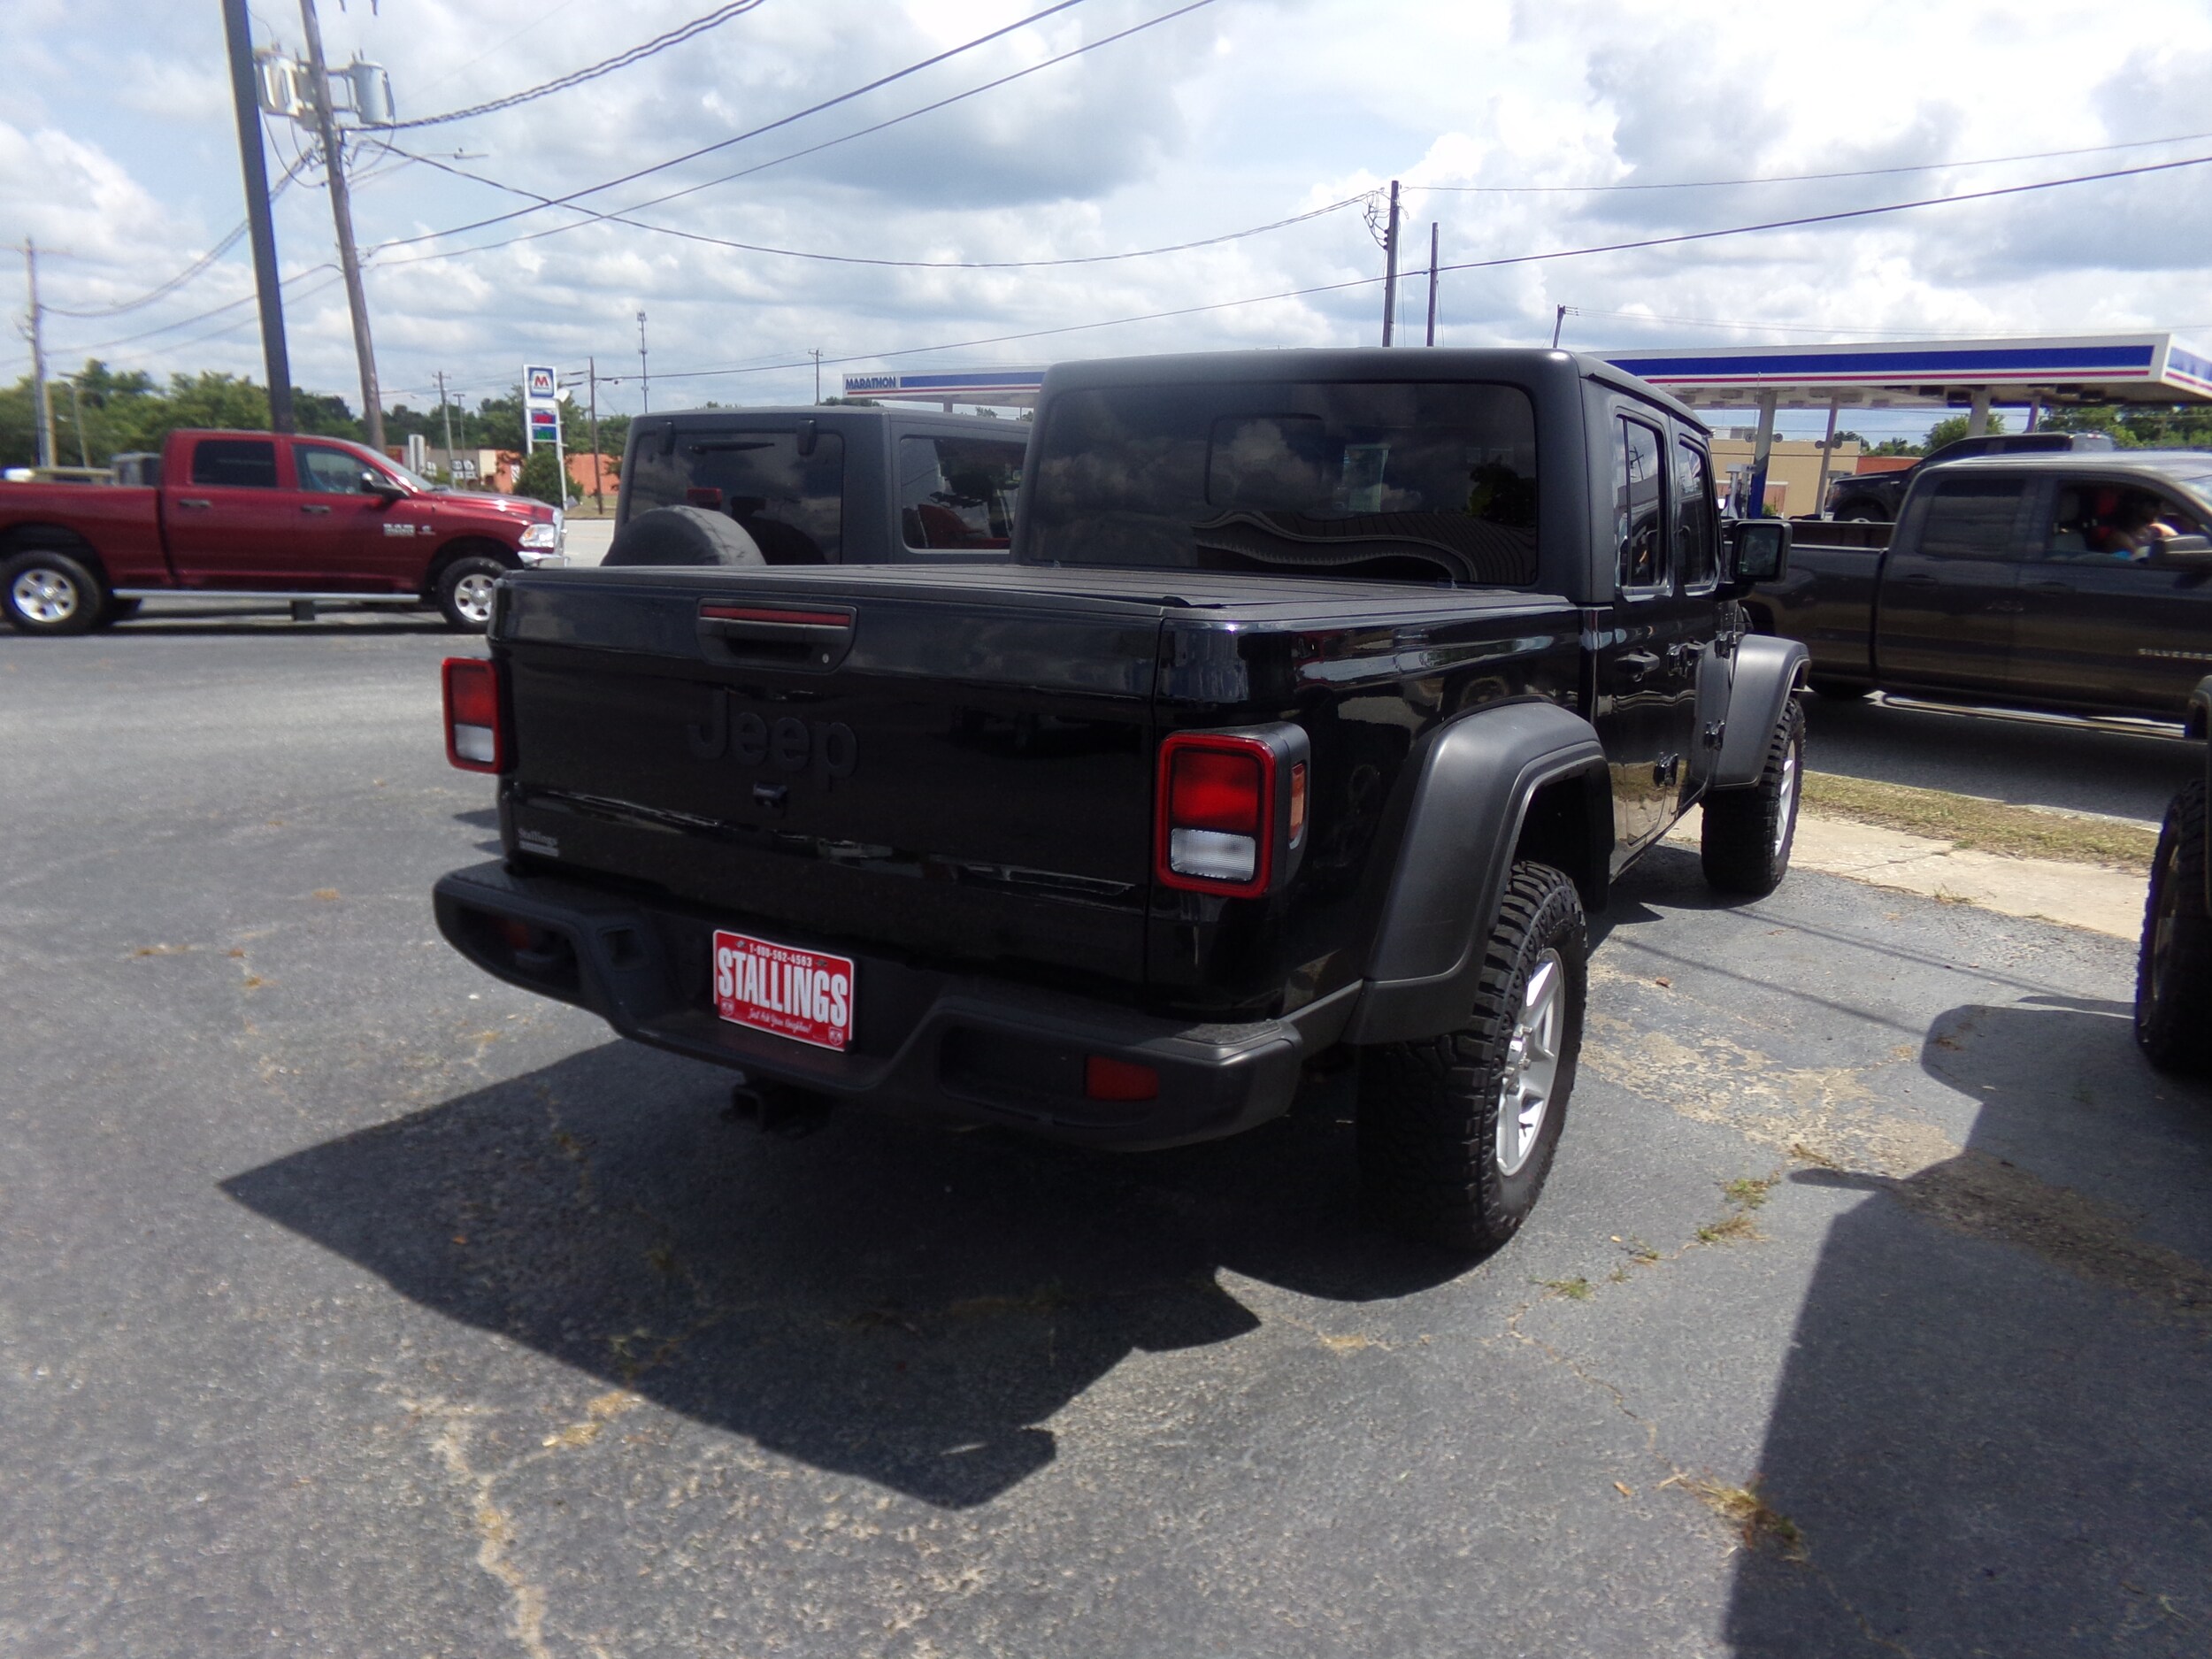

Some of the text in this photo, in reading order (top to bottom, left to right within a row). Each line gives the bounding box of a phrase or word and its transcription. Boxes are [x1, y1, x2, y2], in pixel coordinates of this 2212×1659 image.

[845, 377, 896, 389] MARATHON
[686, 688, 859, 793] Jeep
[749, 943, 812, 967] 1-800-562-4563
[718, 947, 849, 1027] STALLINGS
